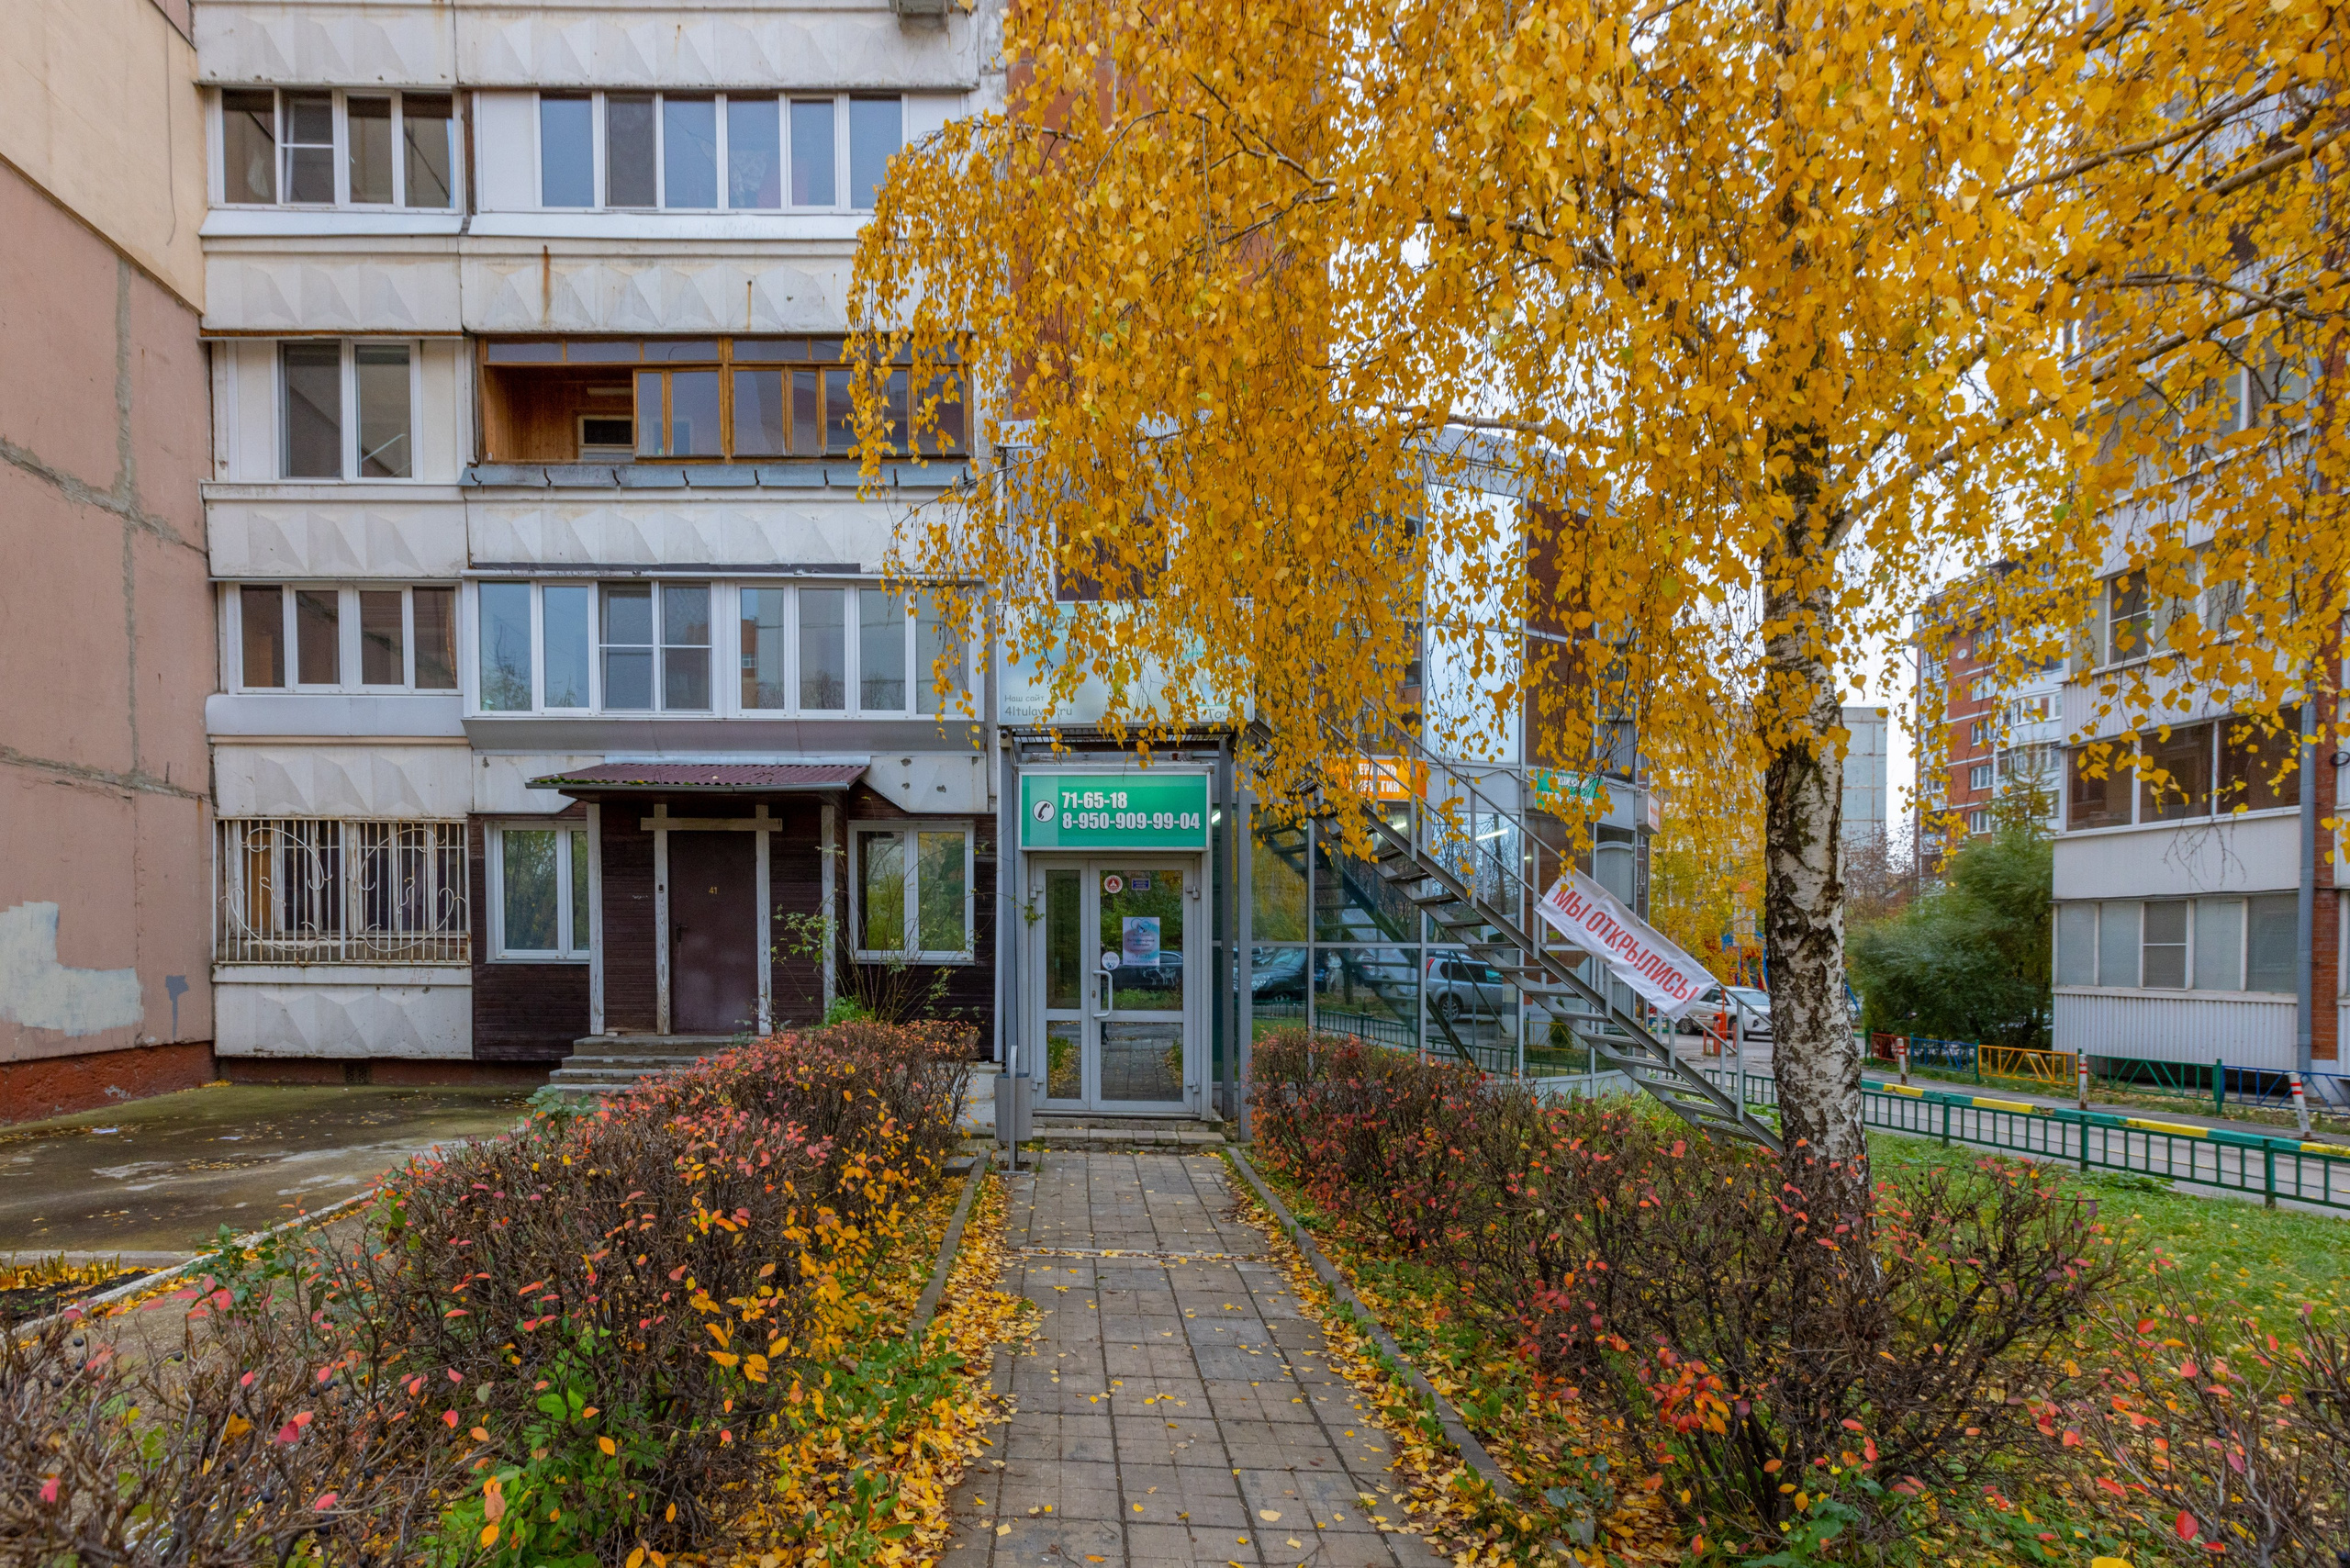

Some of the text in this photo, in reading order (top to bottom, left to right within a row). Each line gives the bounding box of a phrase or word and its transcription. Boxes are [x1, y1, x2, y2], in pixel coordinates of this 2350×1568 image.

[1004, 693, 1045, 702] Наш сайт
[1061, 791, 1128, 809] 71-65-18
[1062, 812, 1201, 830] 8-950-909-99-04
[709, 886, 718, 895] 41
[1552, 887, 1700, 1004] МЫ ОТКРЫЛИСЬ!
